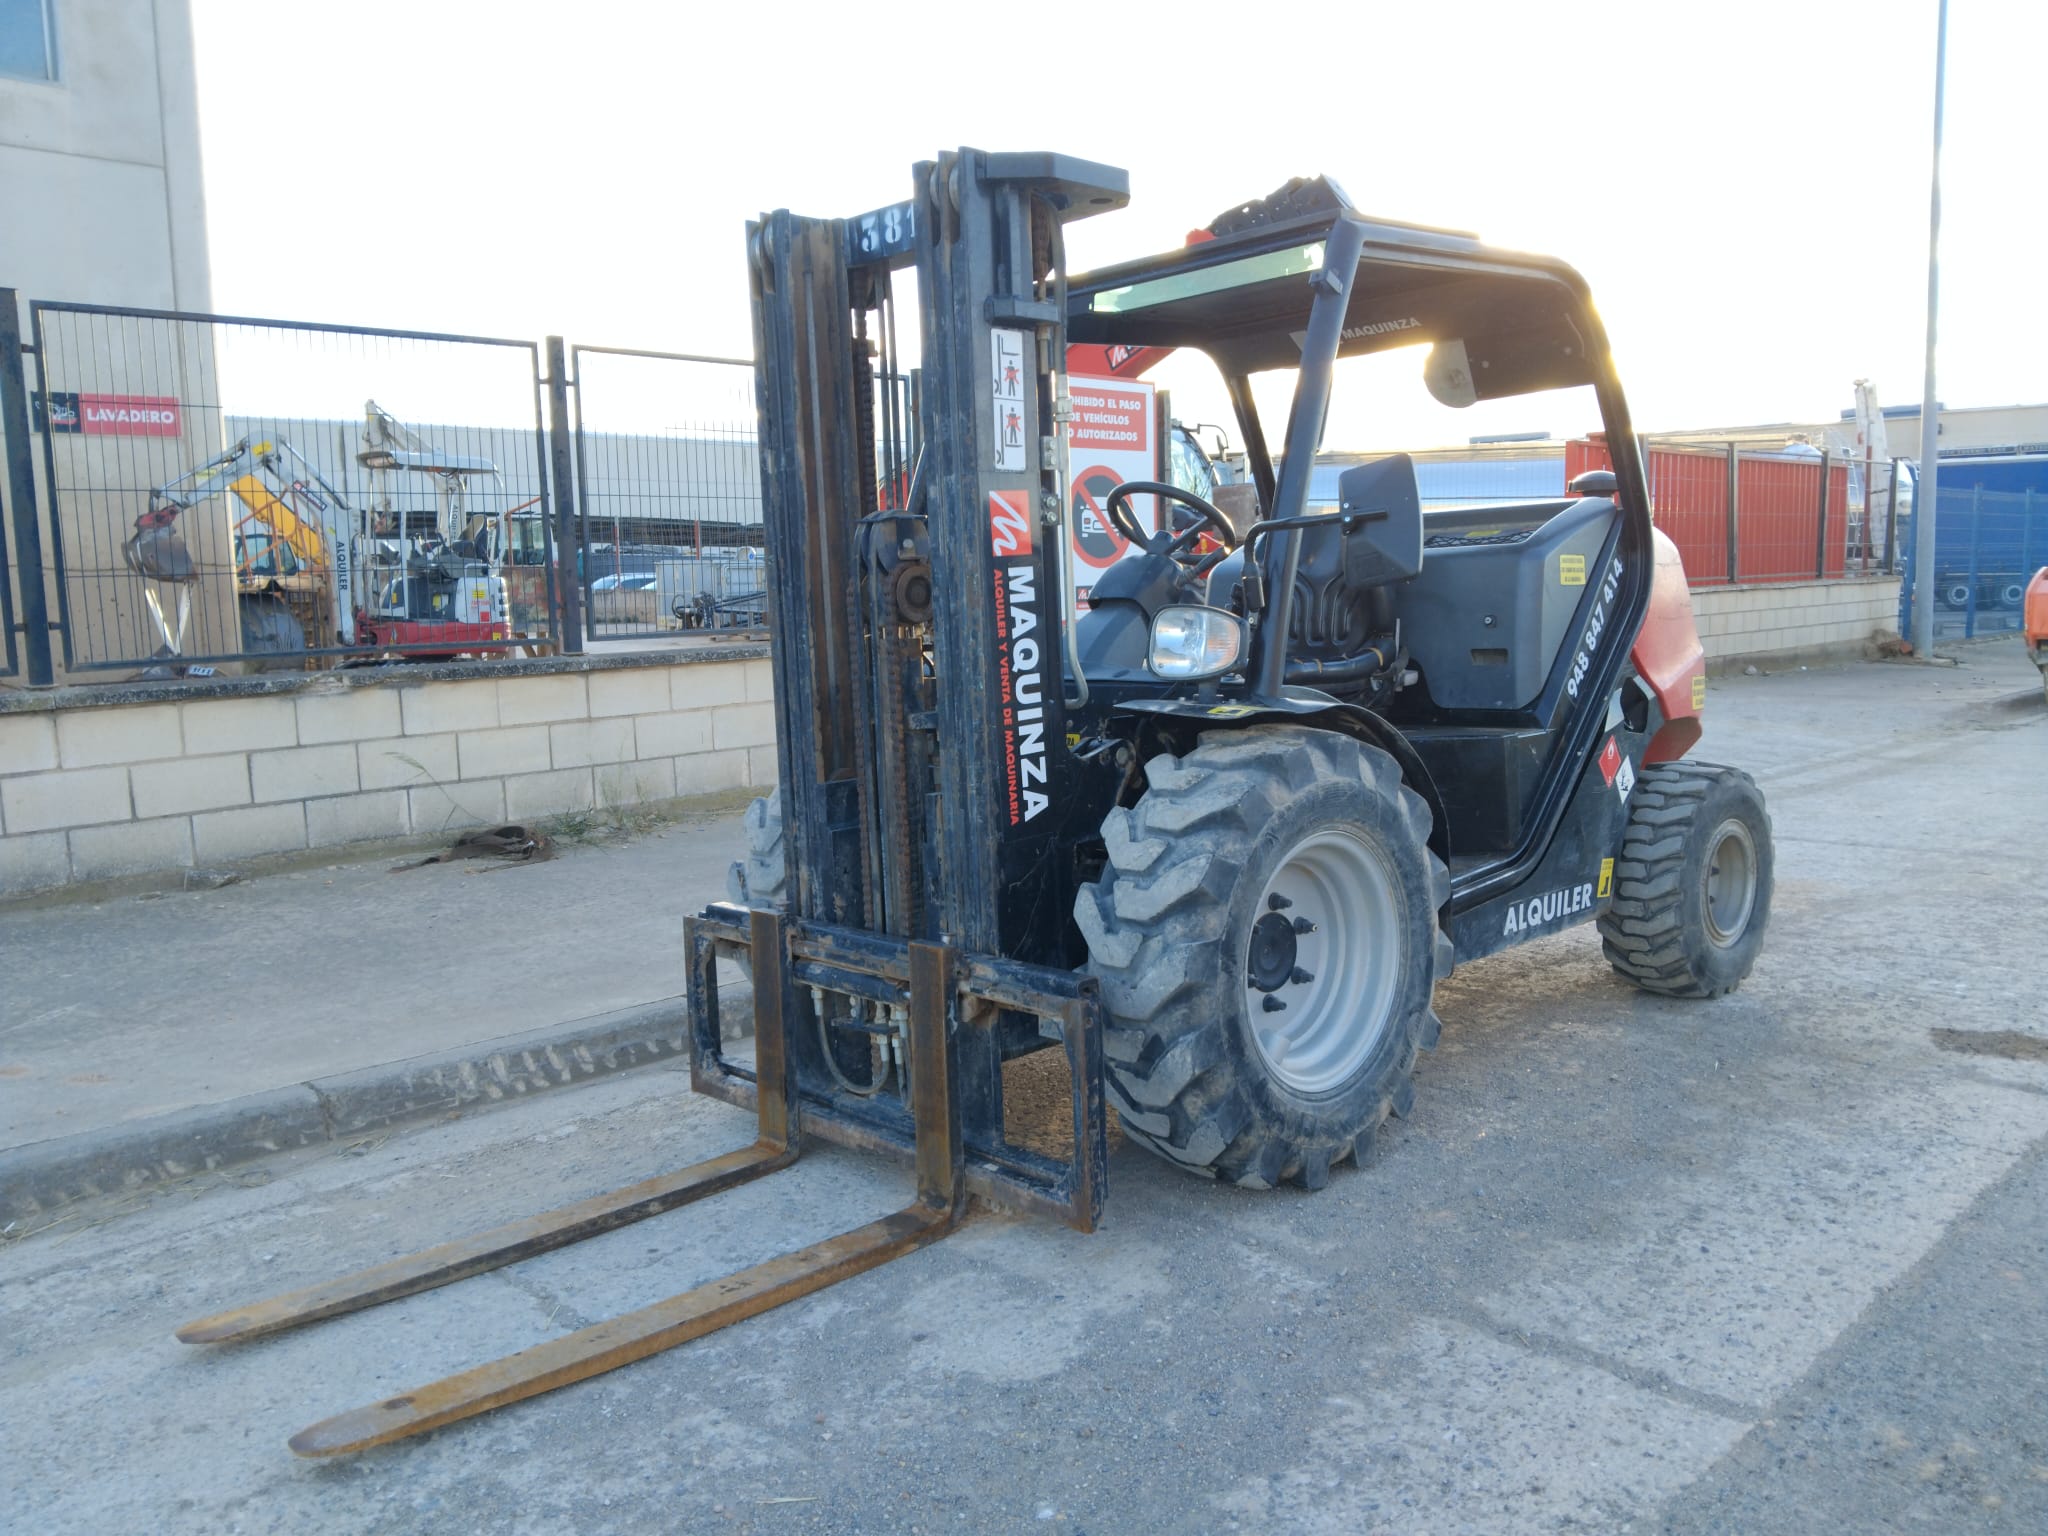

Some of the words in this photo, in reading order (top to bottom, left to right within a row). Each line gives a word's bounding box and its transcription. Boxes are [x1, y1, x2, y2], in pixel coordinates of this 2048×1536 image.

[861, 202, 915, 252] 381
[1341, 317, 1422, 340] MAQUINZA
[86, 407, 175, 425] LAVADERO
[1083, 410, 1130, 426] VEHÍCULOS
[1107, 398, 1117, 409] EL
[1119, 399, 1141, 411] PASO
[1077, 428, 1138, 442] AUTORIZADOS
[336, 541, 348, 591] ALQUILER
[994, 569, 1007, 638] ALQUILER
[1567, 651, 1589, 698] 948
[1585, 601, 1605, 651] 847
[1603, 557, 1624, 604] 414
[998, 642, 1008, 652] Y
[1000, 656, 1011, 704] VENTA
[1007, 566, 1049, 823] MAQUINZA
[1003, 708, 1013, 726] DE
[1004, 730, 1019, 826] MAQUINARIA
[1503, 883, 1593, 936] ALQUILER
